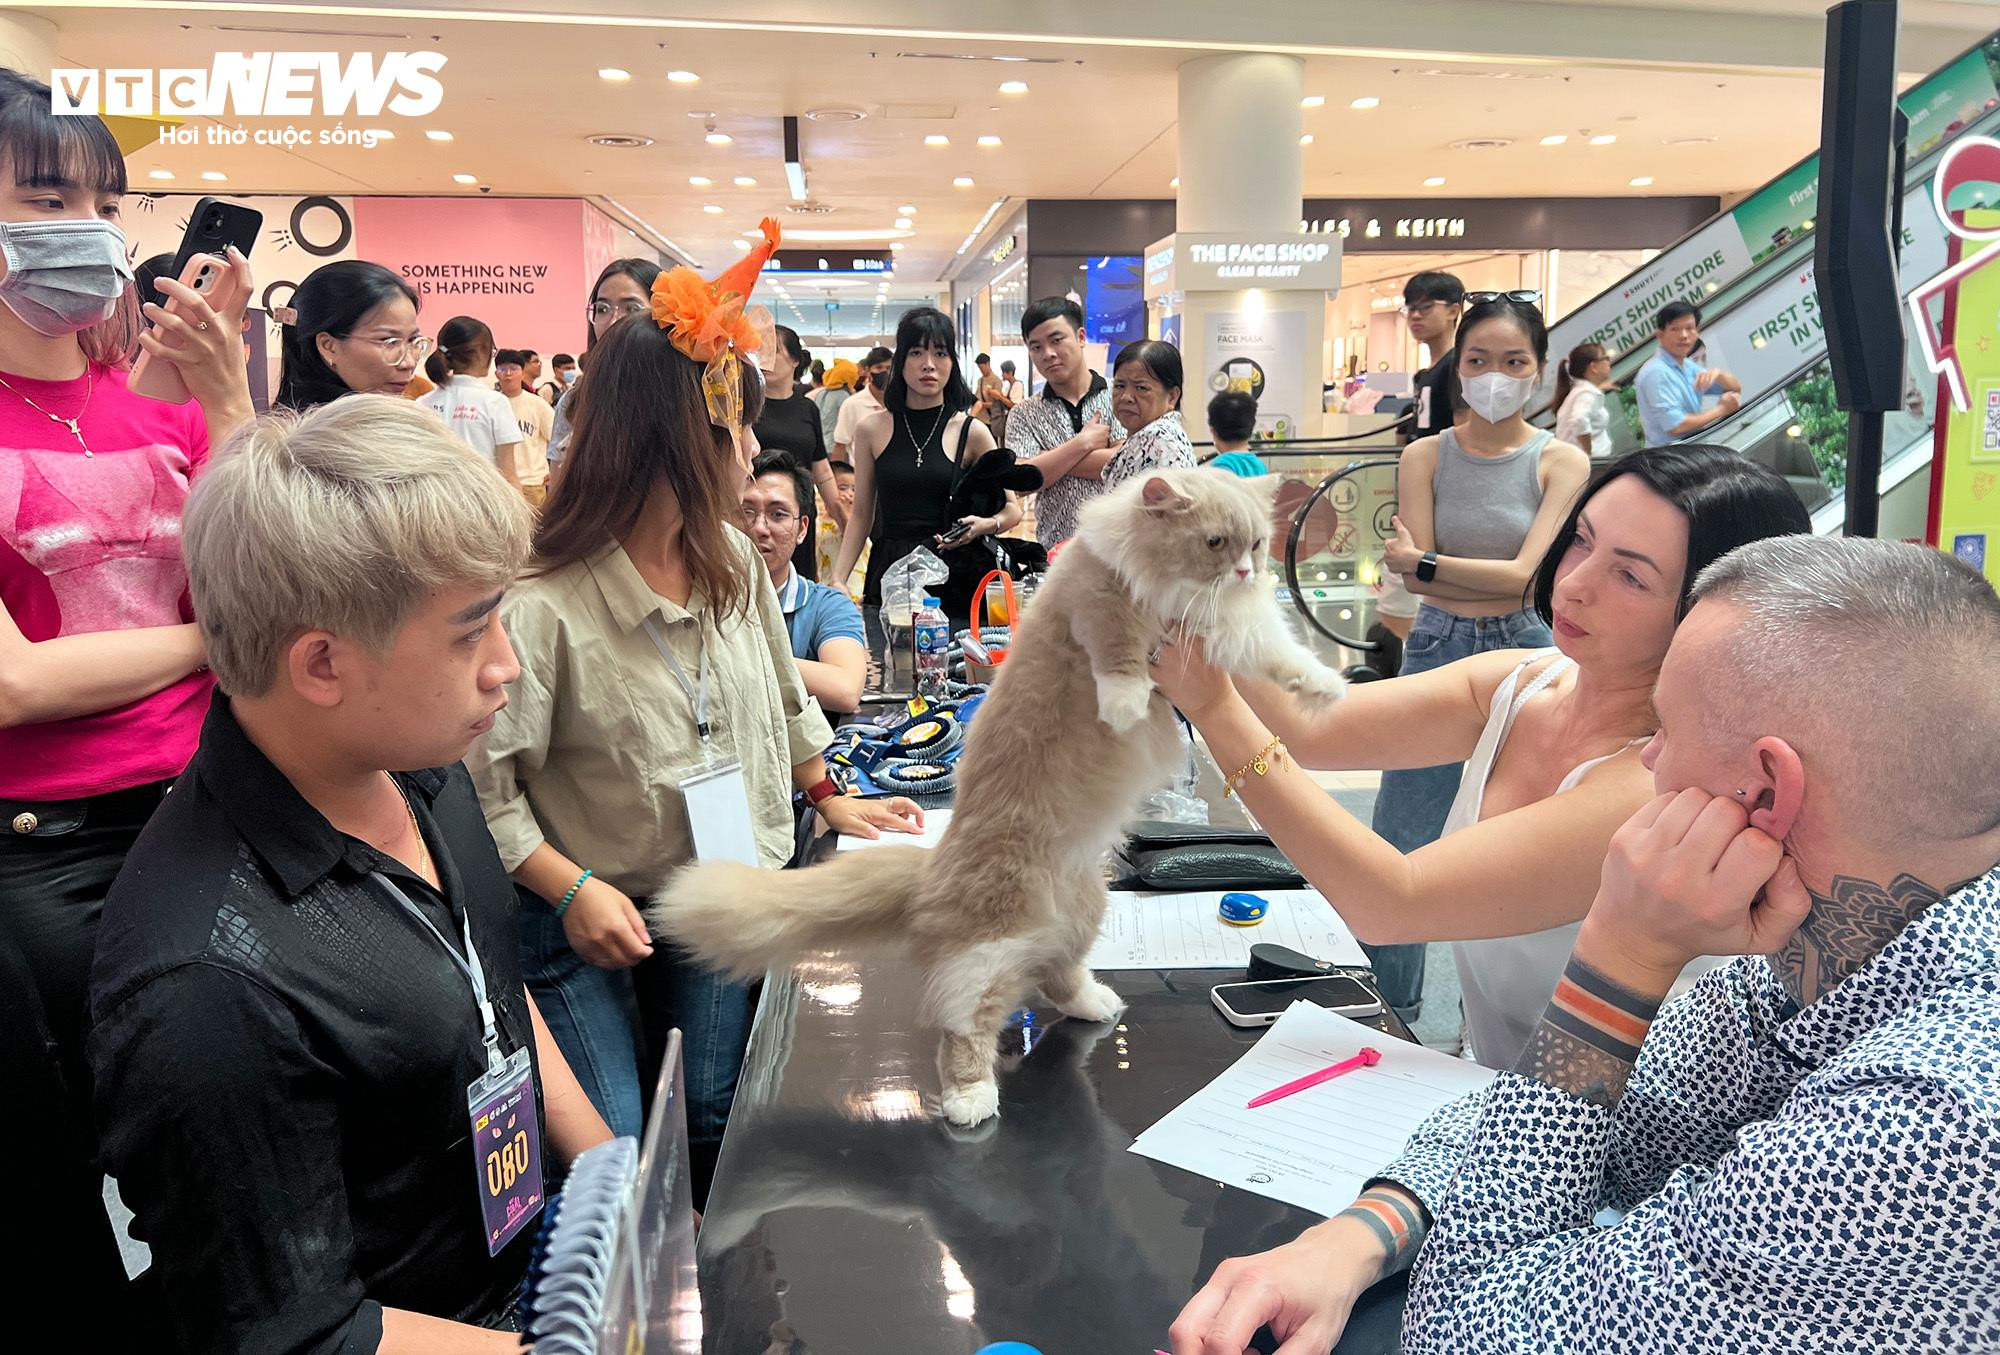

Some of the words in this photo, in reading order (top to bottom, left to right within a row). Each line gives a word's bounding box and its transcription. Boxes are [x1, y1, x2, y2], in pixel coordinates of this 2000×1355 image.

[1365, 218, 1381, 238] &
[1396, 218, 1465, 238] KEITH
[401, 264, 504, 278] SOMETHING
[509, 265, 548, 278] NEW
[417, 281, 431, 294] IS
[436, 281, 535, 295] HAPPENING
[1625, 284, 1673, 324] SHUYI
[1673, 249, 1726, 292] STORE
[1748, 303, 1799, 350] FIRST
[1789, 322, 1811, 348] IN
[1217, 335, 1239, 344] FACE
[1240, 335, 1264, 344] MASK
[1615, 331, 1634, 352] IN
[487, 1129, 530, 1197] 080
